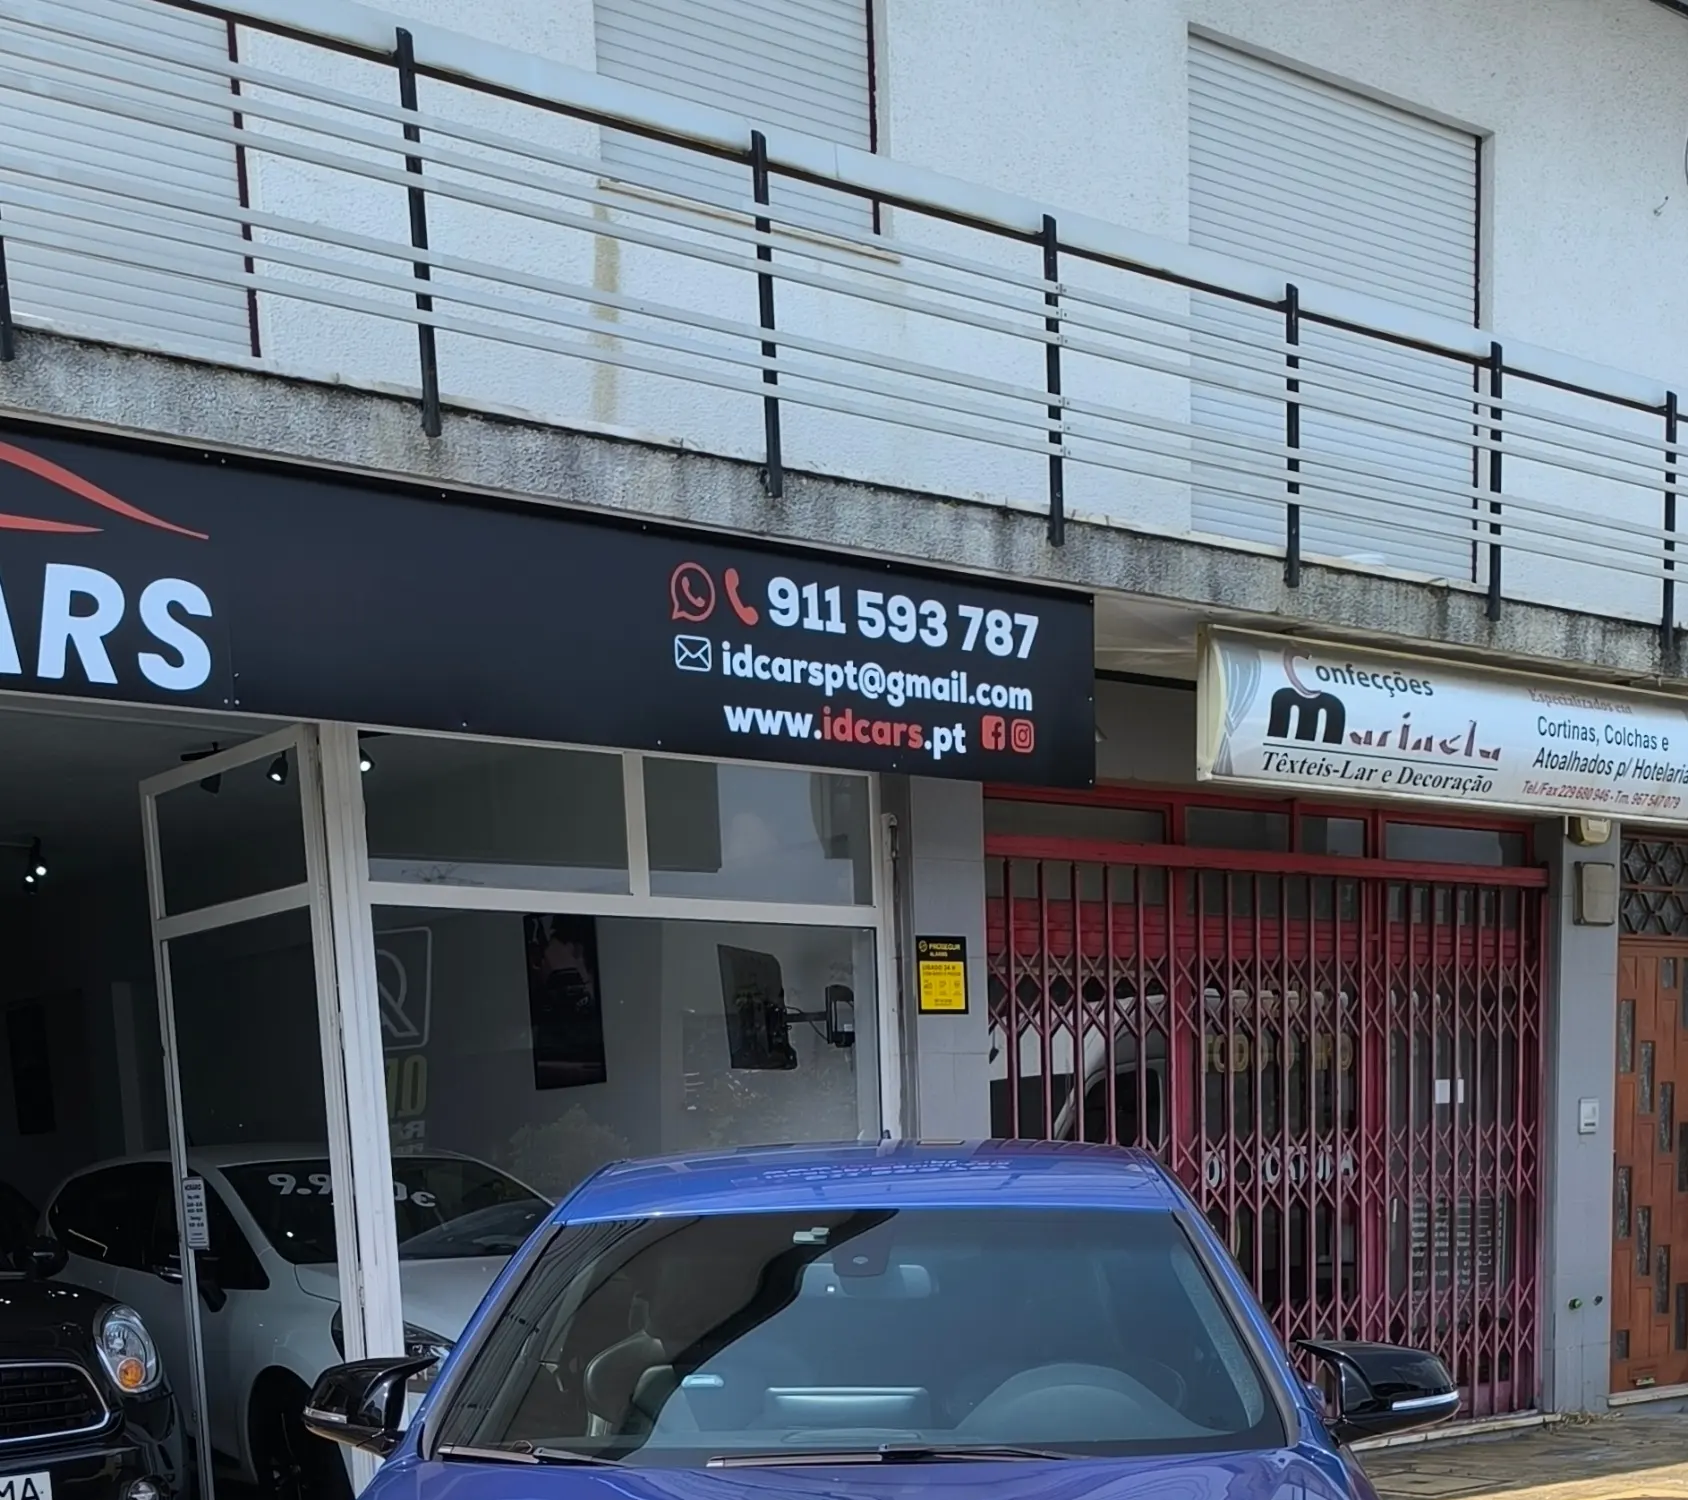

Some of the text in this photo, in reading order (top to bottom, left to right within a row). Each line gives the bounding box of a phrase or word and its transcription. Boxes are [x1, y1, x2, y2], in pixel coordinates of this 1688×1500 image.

[767, 576, 1039, 659] 911 593 787
[722, 641, 1033, 711] idcarspt@gmail.com
[1283, 649, 1434, 699] Confecções
[724, 705, 967, 759] www.idcars.pt
[1537, 715, 1669, 751] Cortinas, Colchas e
[1262, 751, 1493, 796] Têxteis-Lar e Decoração
[1532, 747, 1688, 785] Atoalhados p/ Hotelaria
